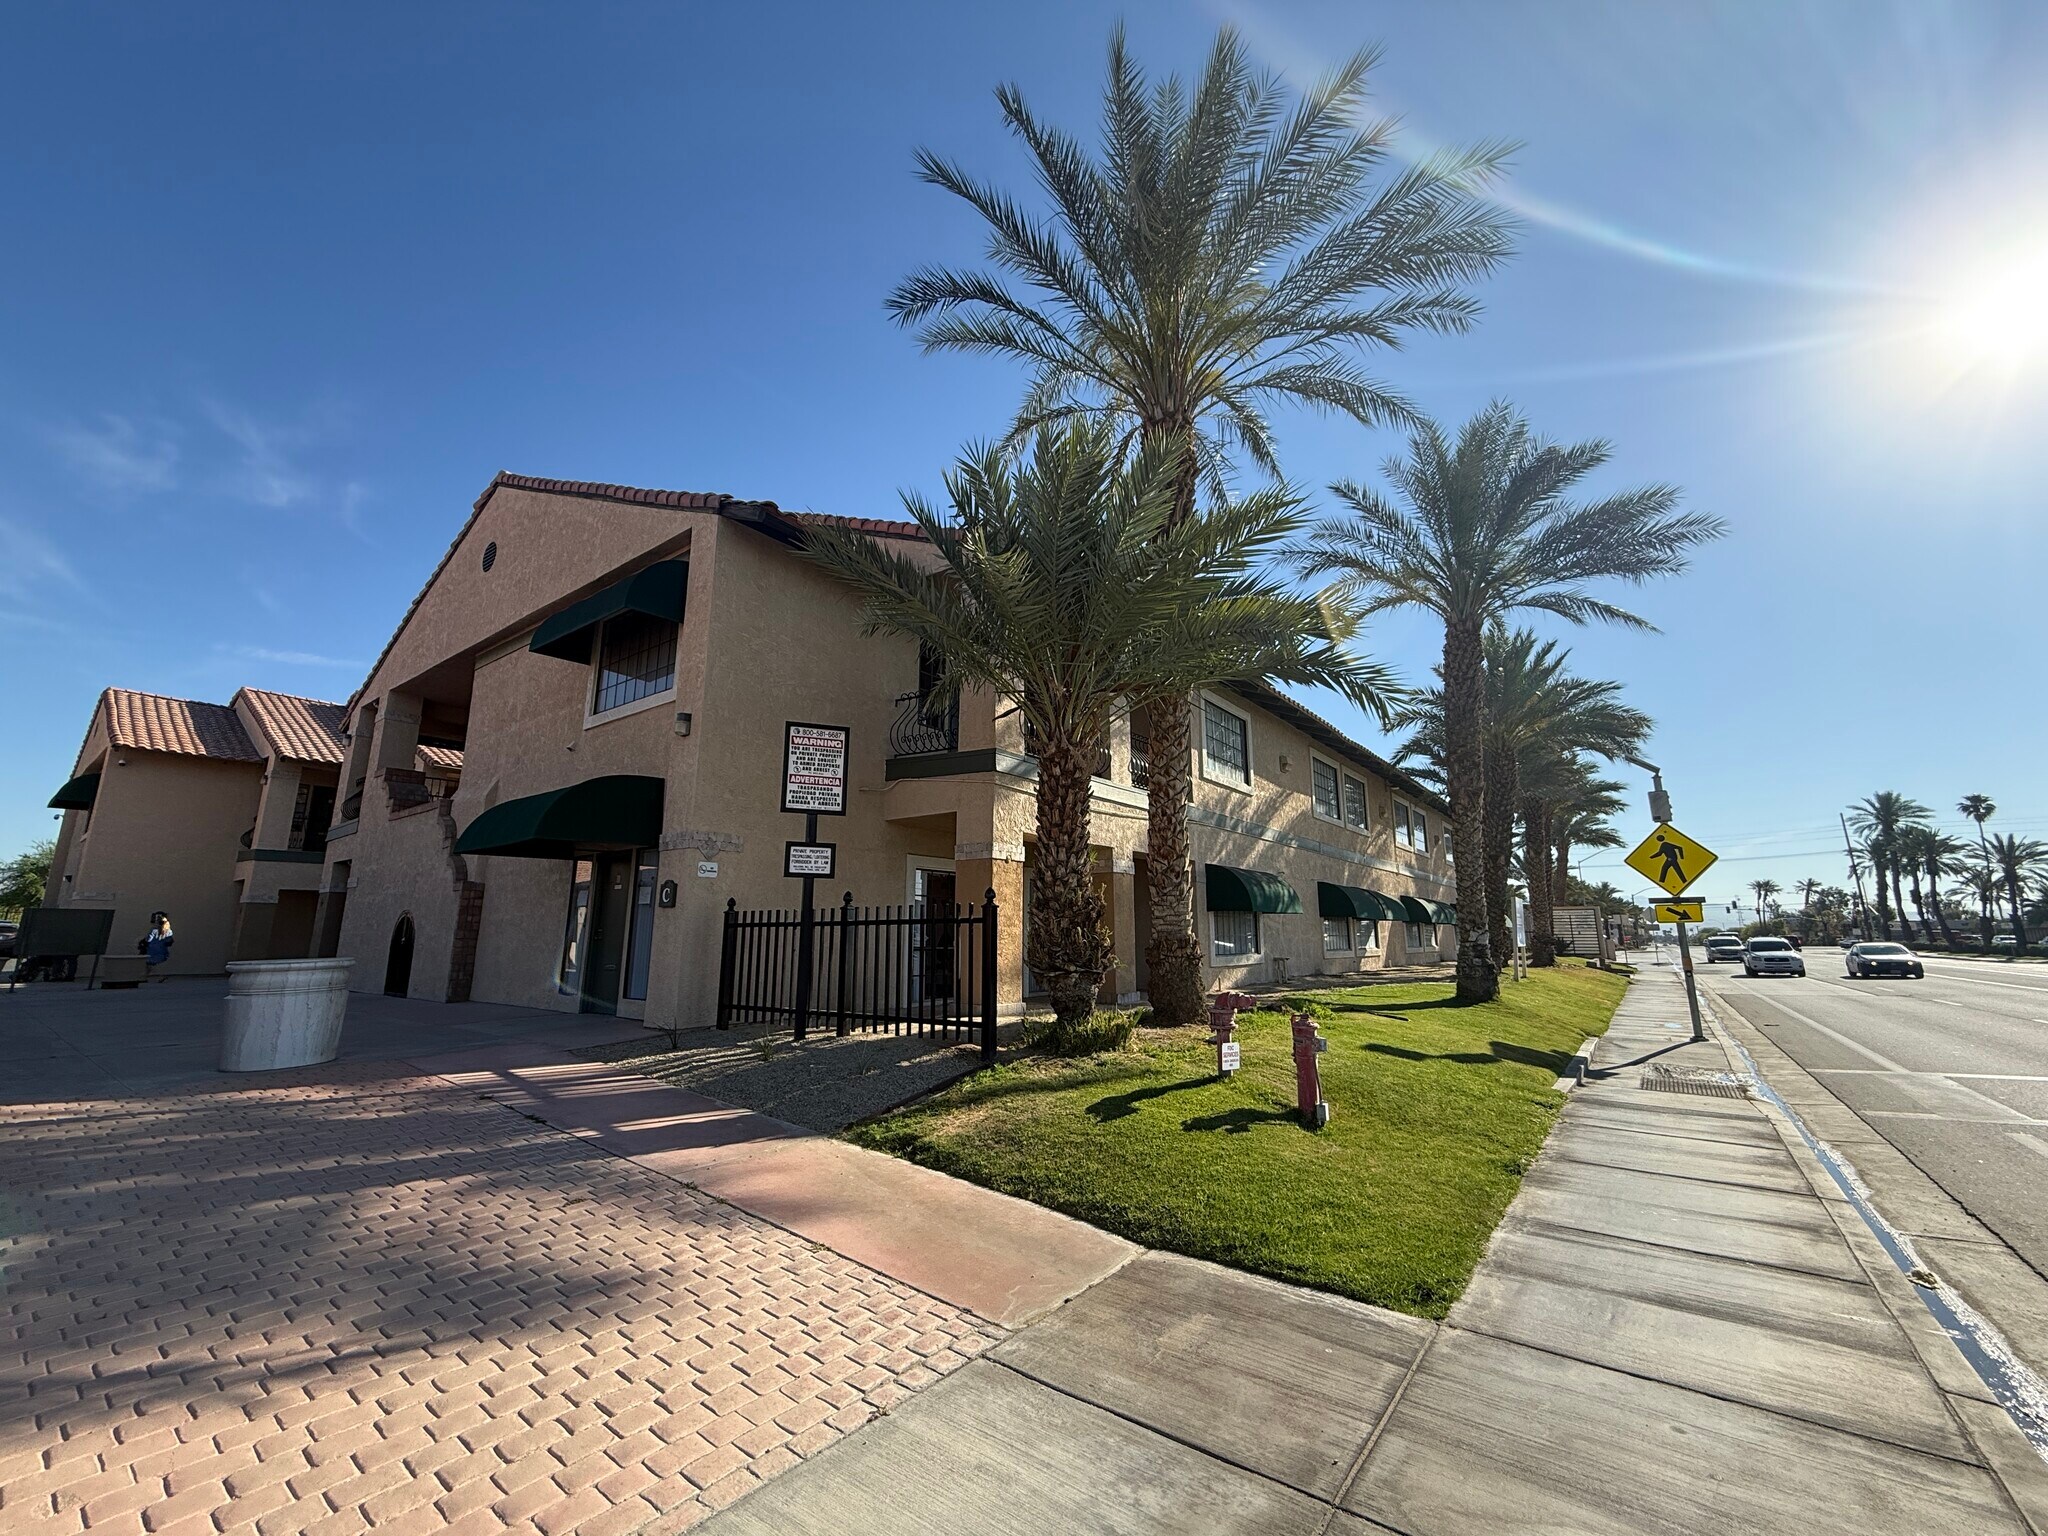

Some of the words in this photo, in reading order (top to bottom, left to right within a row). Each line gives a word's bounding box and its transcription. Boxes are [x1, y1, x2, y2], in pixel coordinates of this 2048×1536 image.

[793, 737, 841, 747] WARNING
[790, 776, 840, 785] ADVERTENCIA
[662, 888, 670, 902] C
